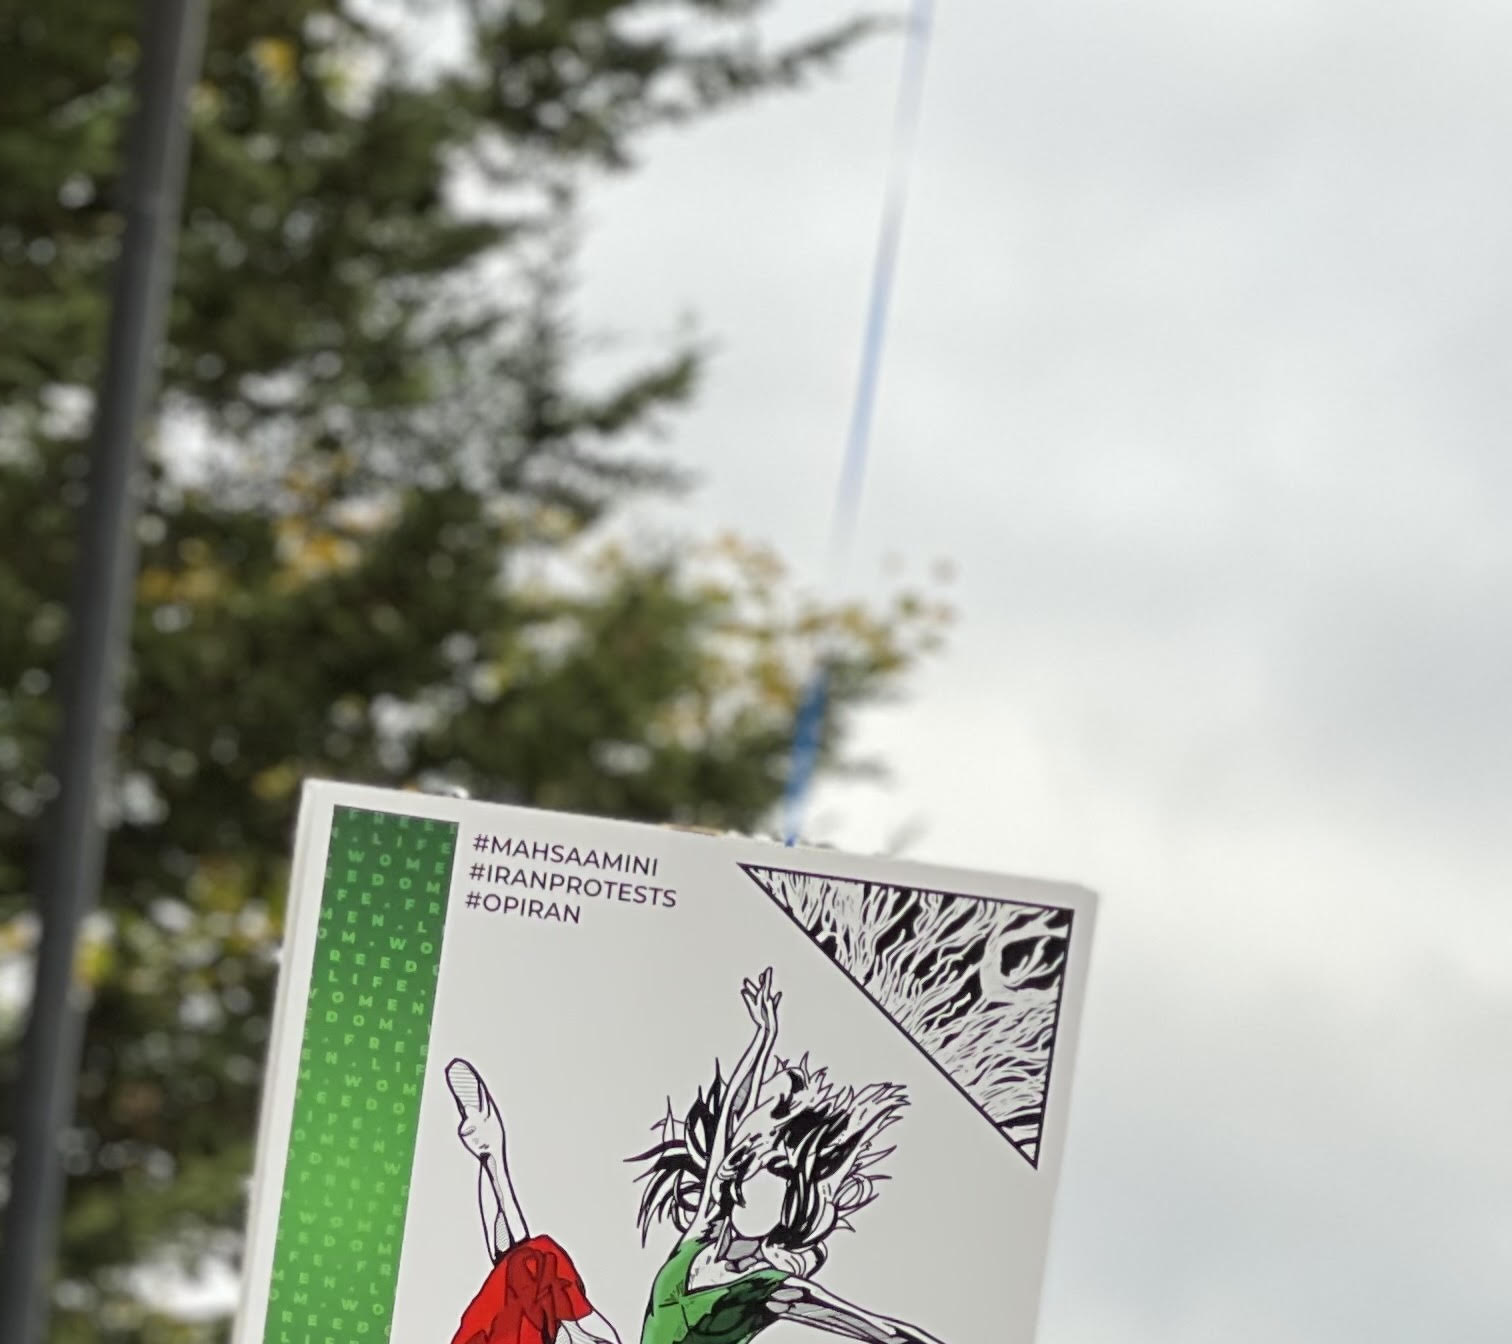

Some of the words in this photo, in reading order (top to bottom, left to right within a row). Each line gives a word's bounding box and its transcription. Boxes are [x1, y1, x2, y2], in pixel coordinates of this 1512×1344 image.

[472, 834, 658, 877] #MAHSAAMINI
[465, 891, 581, 923] #OPIRAN
[469, 863, 677, 908] #IRANPROTESTS
